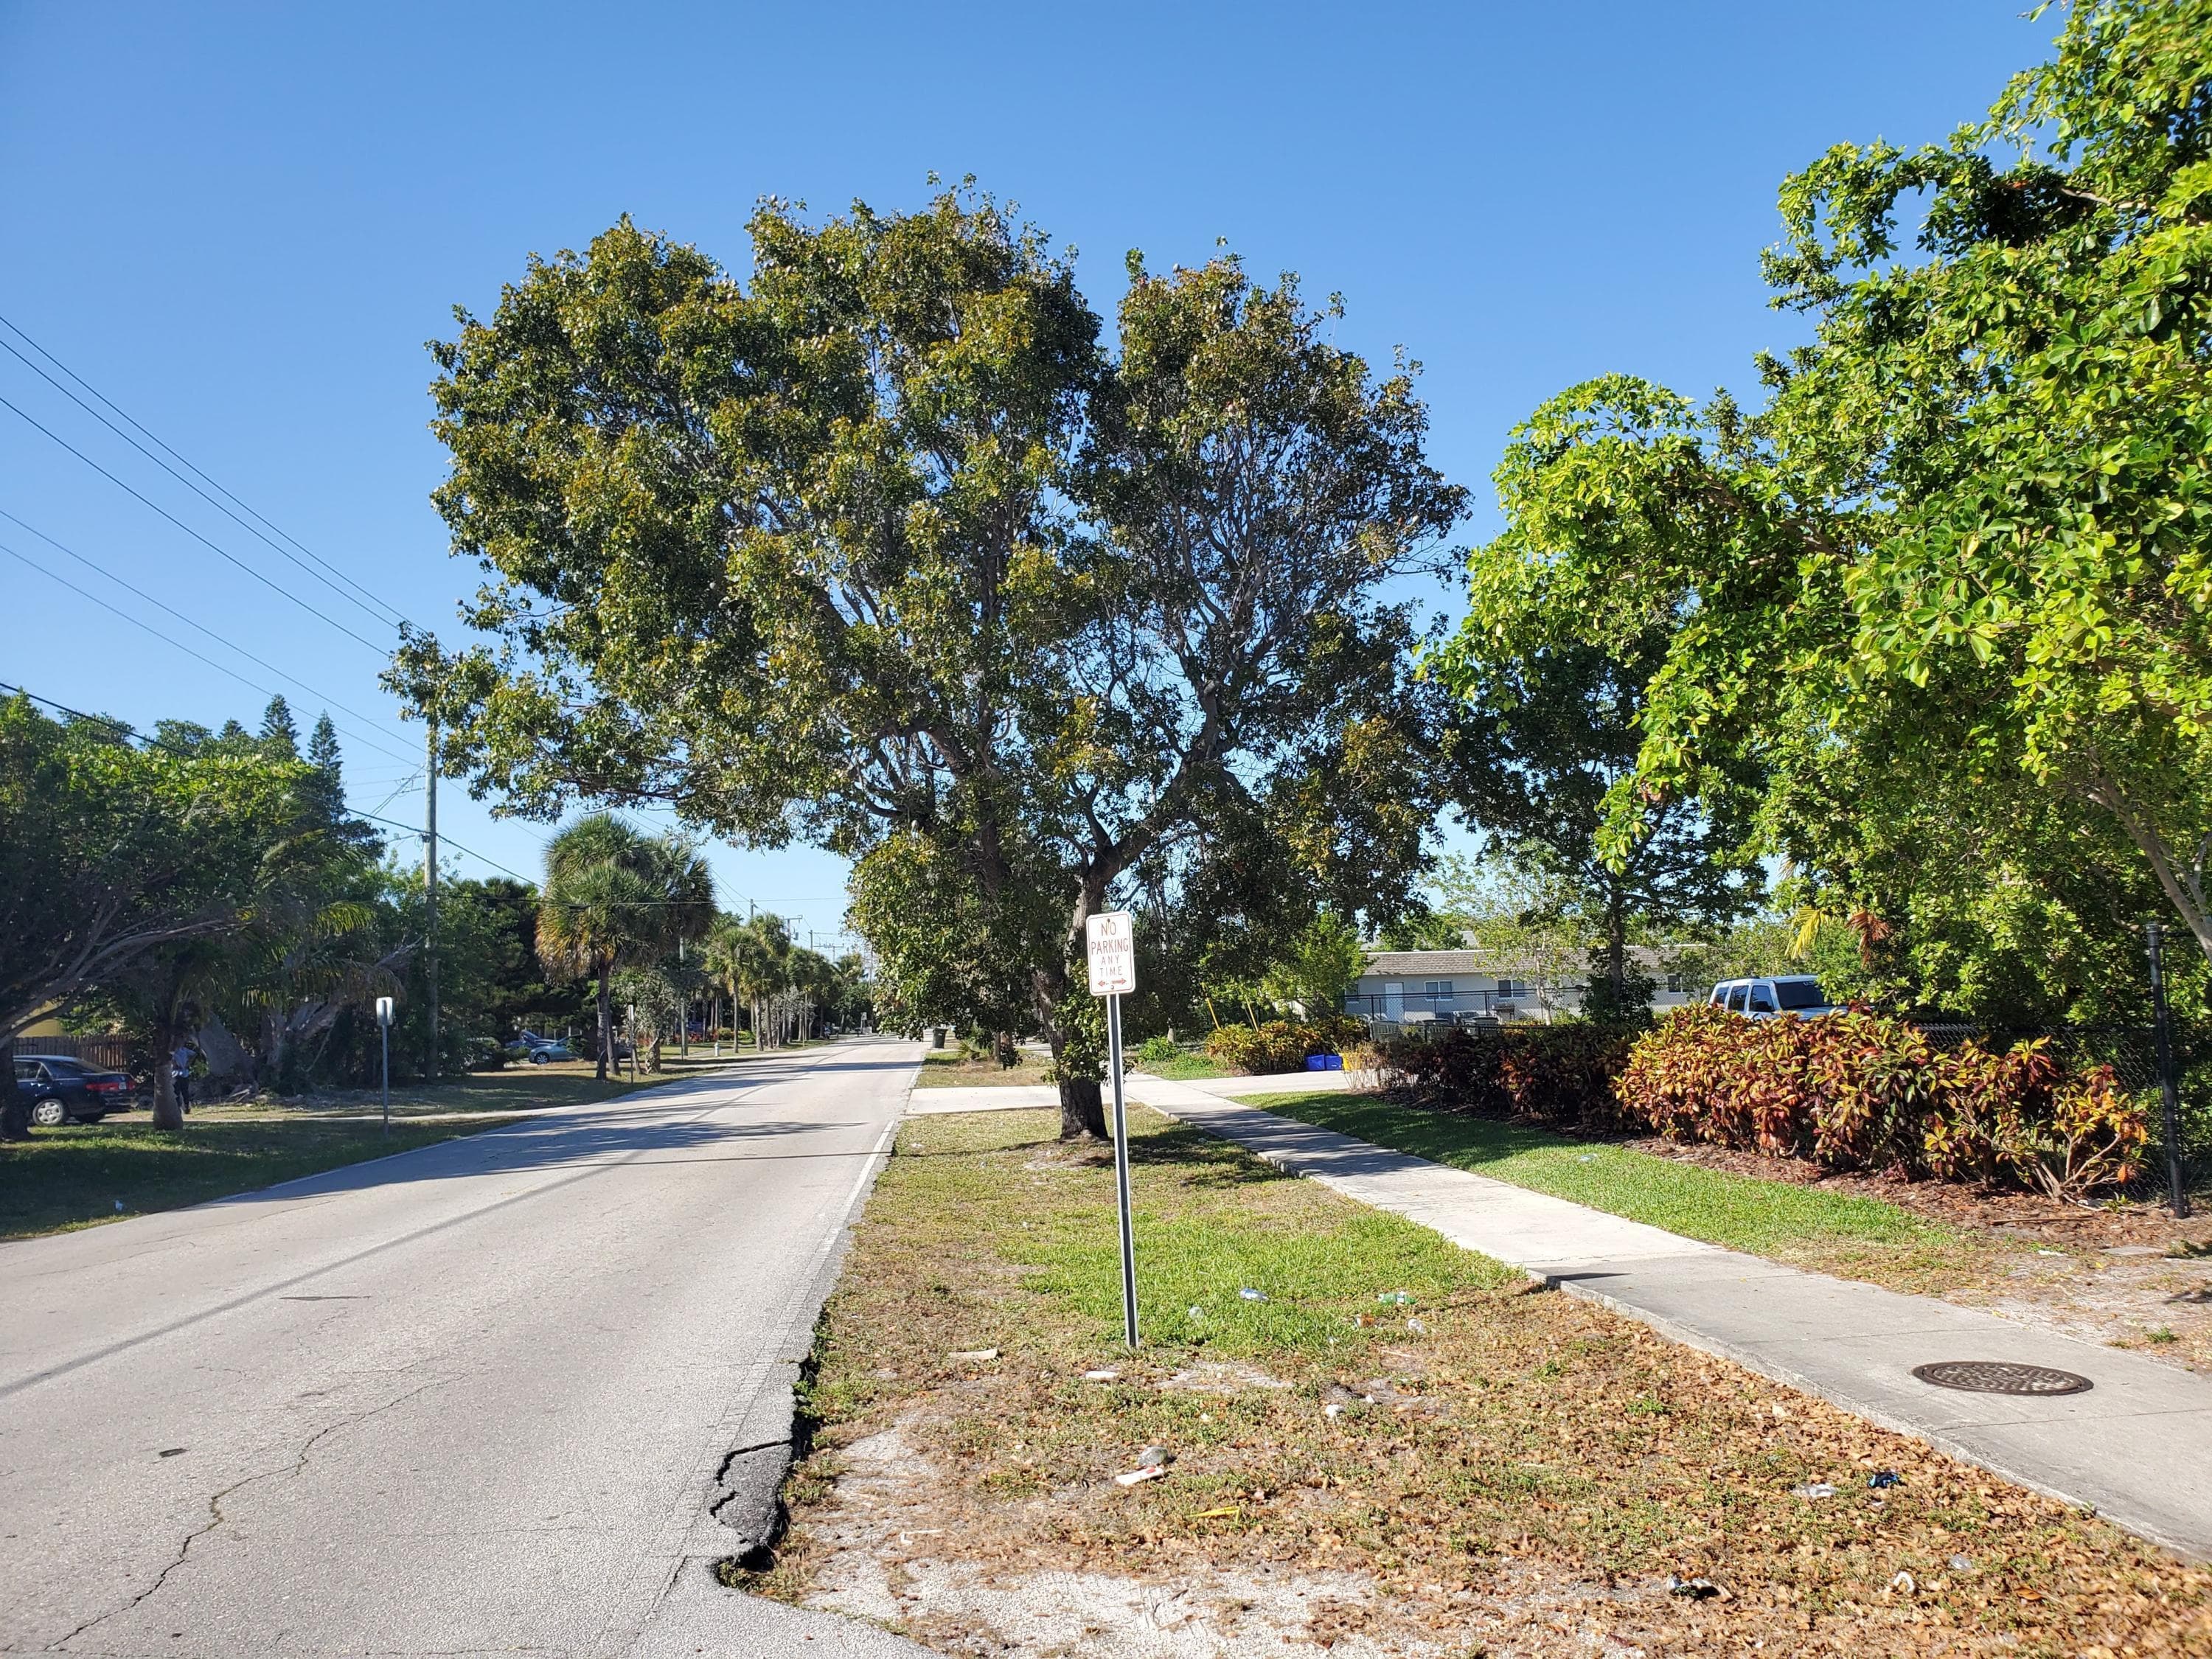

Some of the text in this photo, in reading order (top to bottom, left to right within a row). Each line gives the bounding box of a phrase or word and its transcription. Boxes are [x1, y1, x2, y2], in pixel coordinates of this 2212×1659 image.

[1102, 922, 1116, 936] NO
[1091, 938, 1129, 955] PARKING
[1102, 955, 1119, 965] ANY
[1100, 966, 1122, 977] TIME
